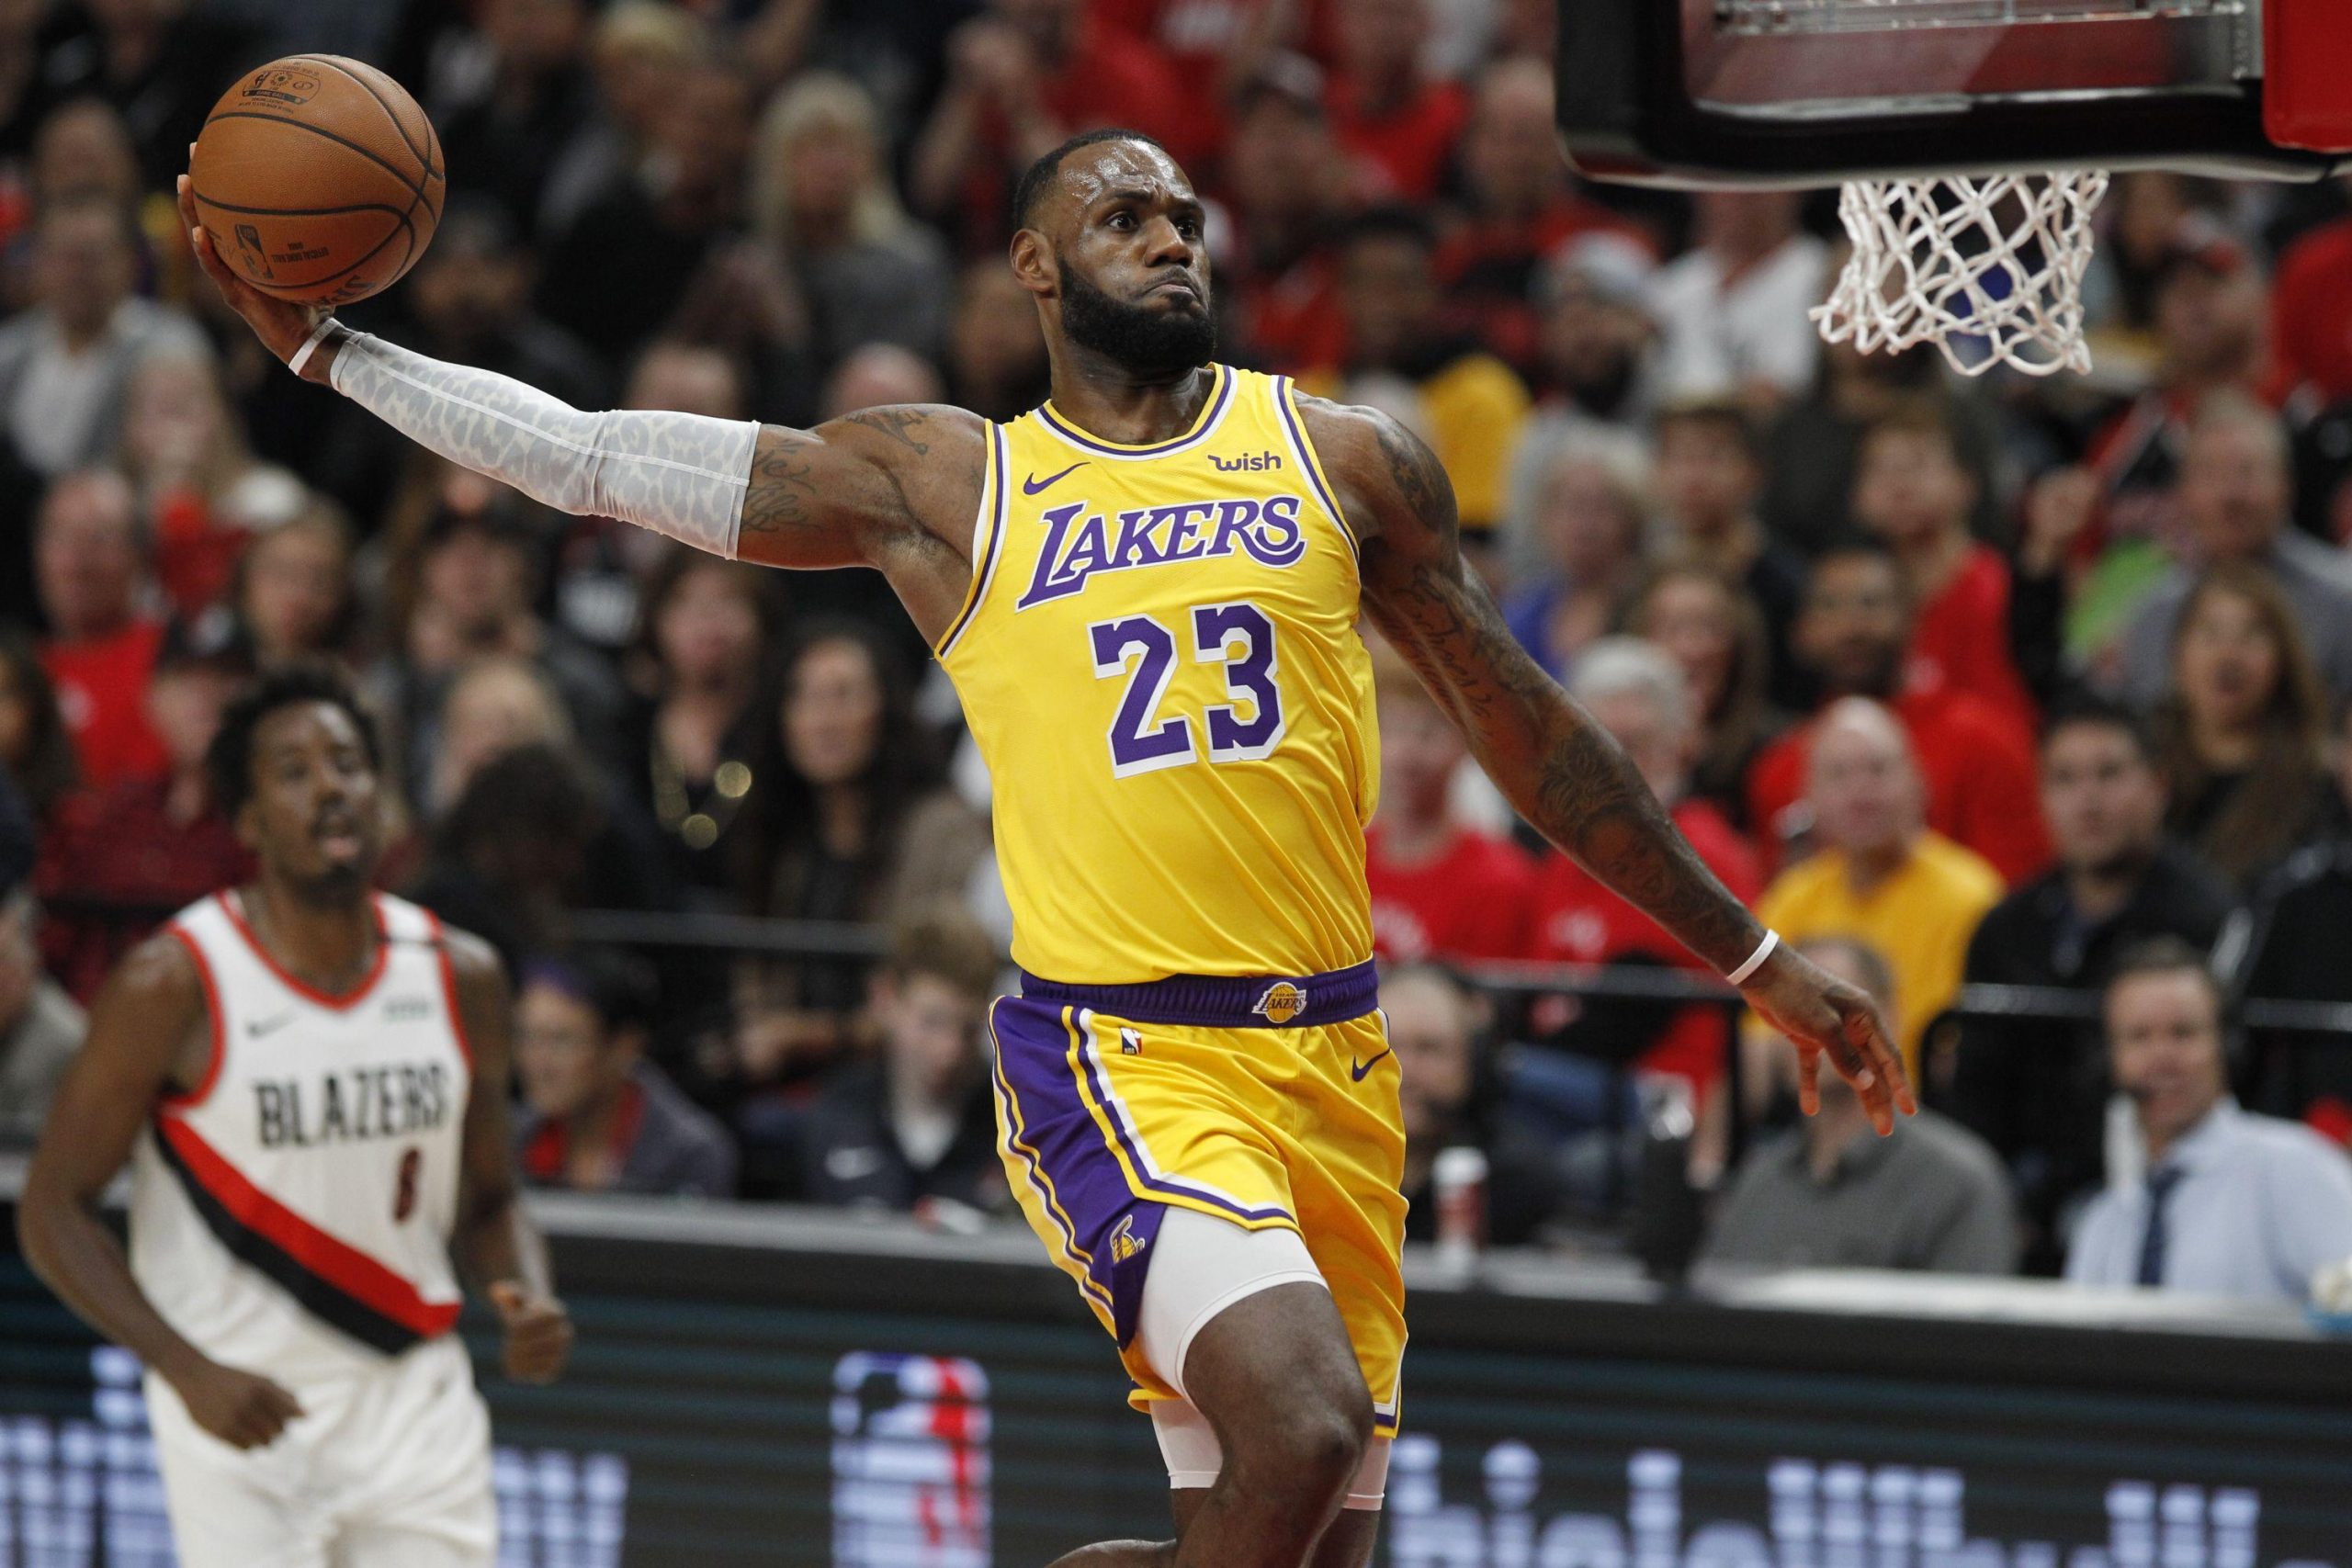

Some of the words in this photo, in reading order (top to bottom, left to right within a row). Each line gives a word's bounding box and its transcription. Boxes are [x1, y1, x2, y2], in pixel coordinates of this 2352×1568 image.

[1207, 450, 1281, 472] wish
[1014, 494, 1307, 614] LAKERS
[1086, 600, 1285, 779] 23
[1256, 991, 1302, 1012] LAKERS
[254, 1063, 447, 1148] BLAZERS
